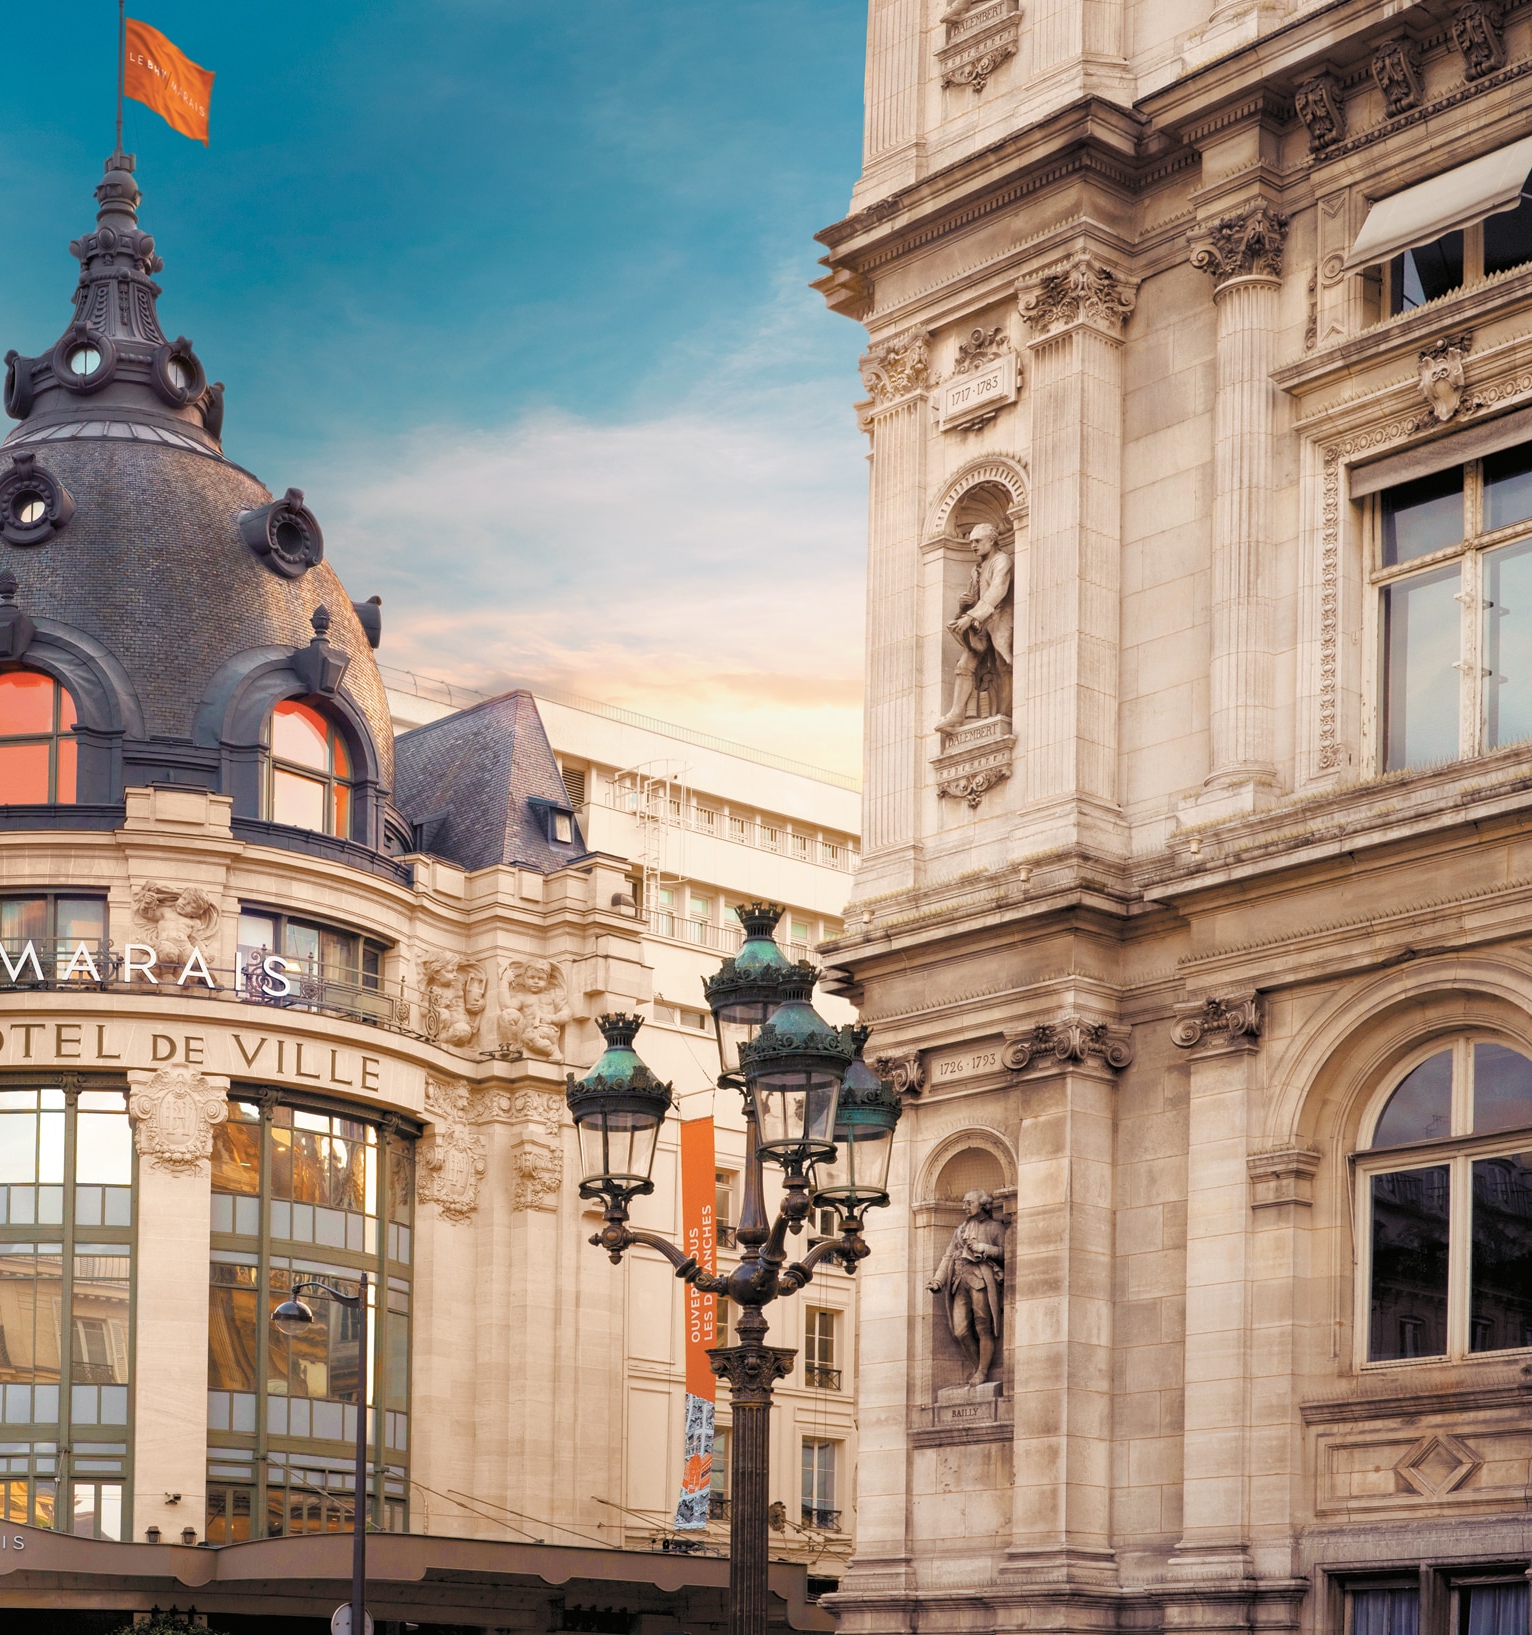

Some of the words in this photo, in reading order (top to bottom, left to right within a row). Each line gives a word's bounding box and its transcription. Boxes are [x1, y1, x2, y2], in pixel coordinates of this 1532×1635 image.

[129, 52, 144, 65] LE
[147, 59, 167, 79] BHV
[171, 80, 205, 117] MARAIS
[150, 1032, 205, 1065] DE
[231, 1033, 382, 1092] VILLE
[702, 1205, 712, 1305] DANCHES
[690, 1282, 701, 1343] OUVER
[704, 1311, 713, 1341] LES
[952, 1407, 979, 1418] BAILLY
